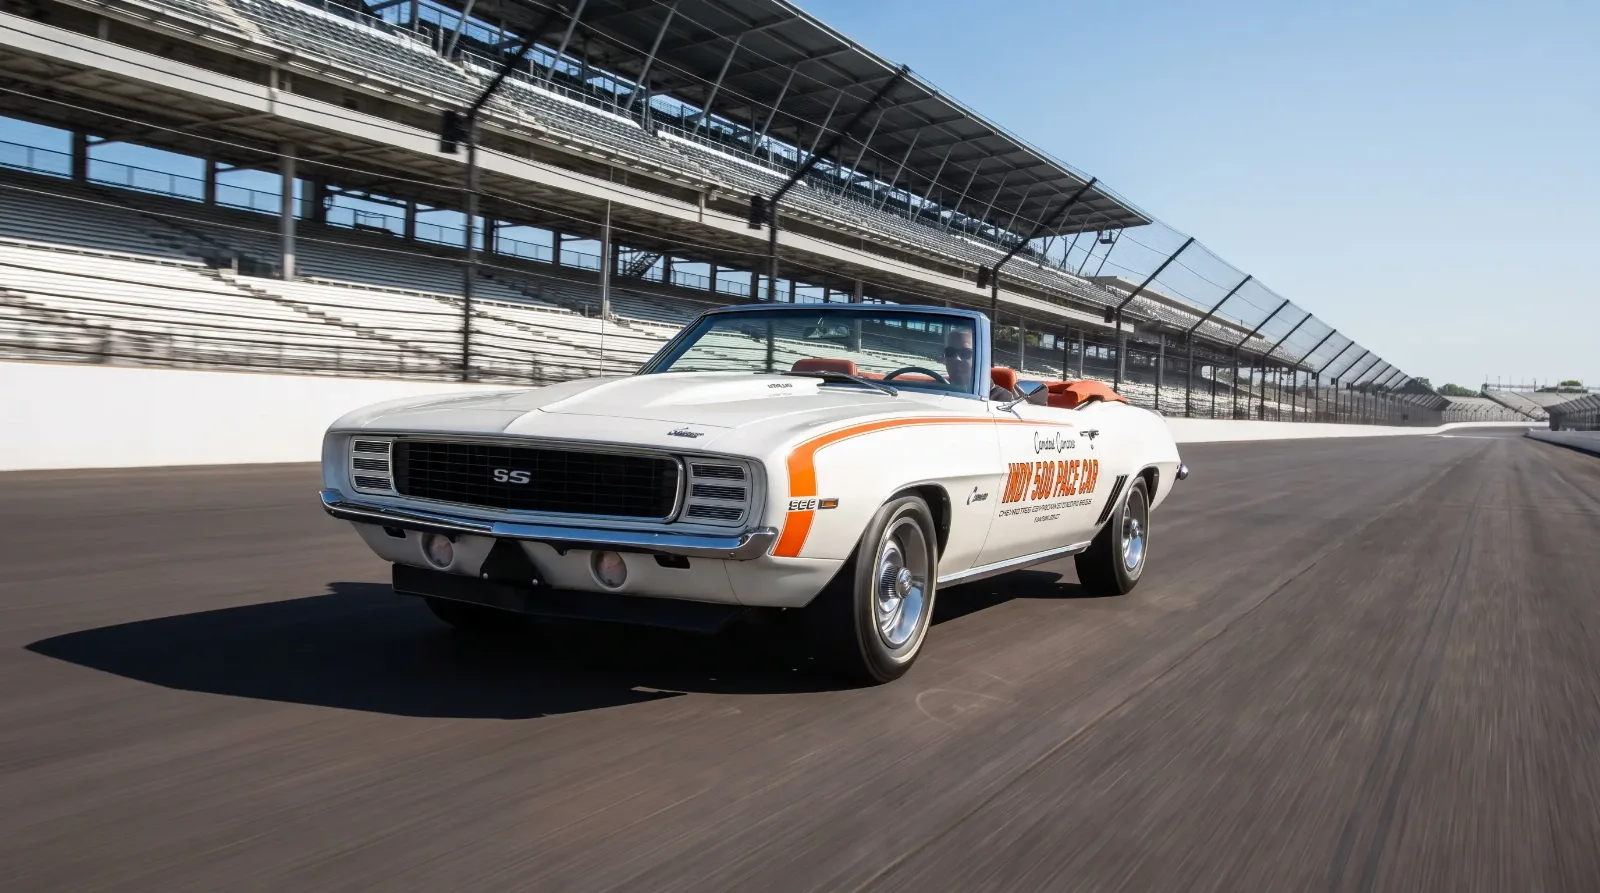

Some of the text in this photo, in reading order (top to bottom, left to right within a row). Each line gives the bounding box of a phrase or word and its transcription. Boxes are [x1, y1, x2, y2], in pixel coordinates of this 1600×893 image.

[493, 468, 531, 484] SS
[1002, 462, 1034, 503] INDY
[1031, 460, 1055, 500] 500
[1053, 459, 1080, 497] PACE
[1079, 458, 1099, 494] CAR
